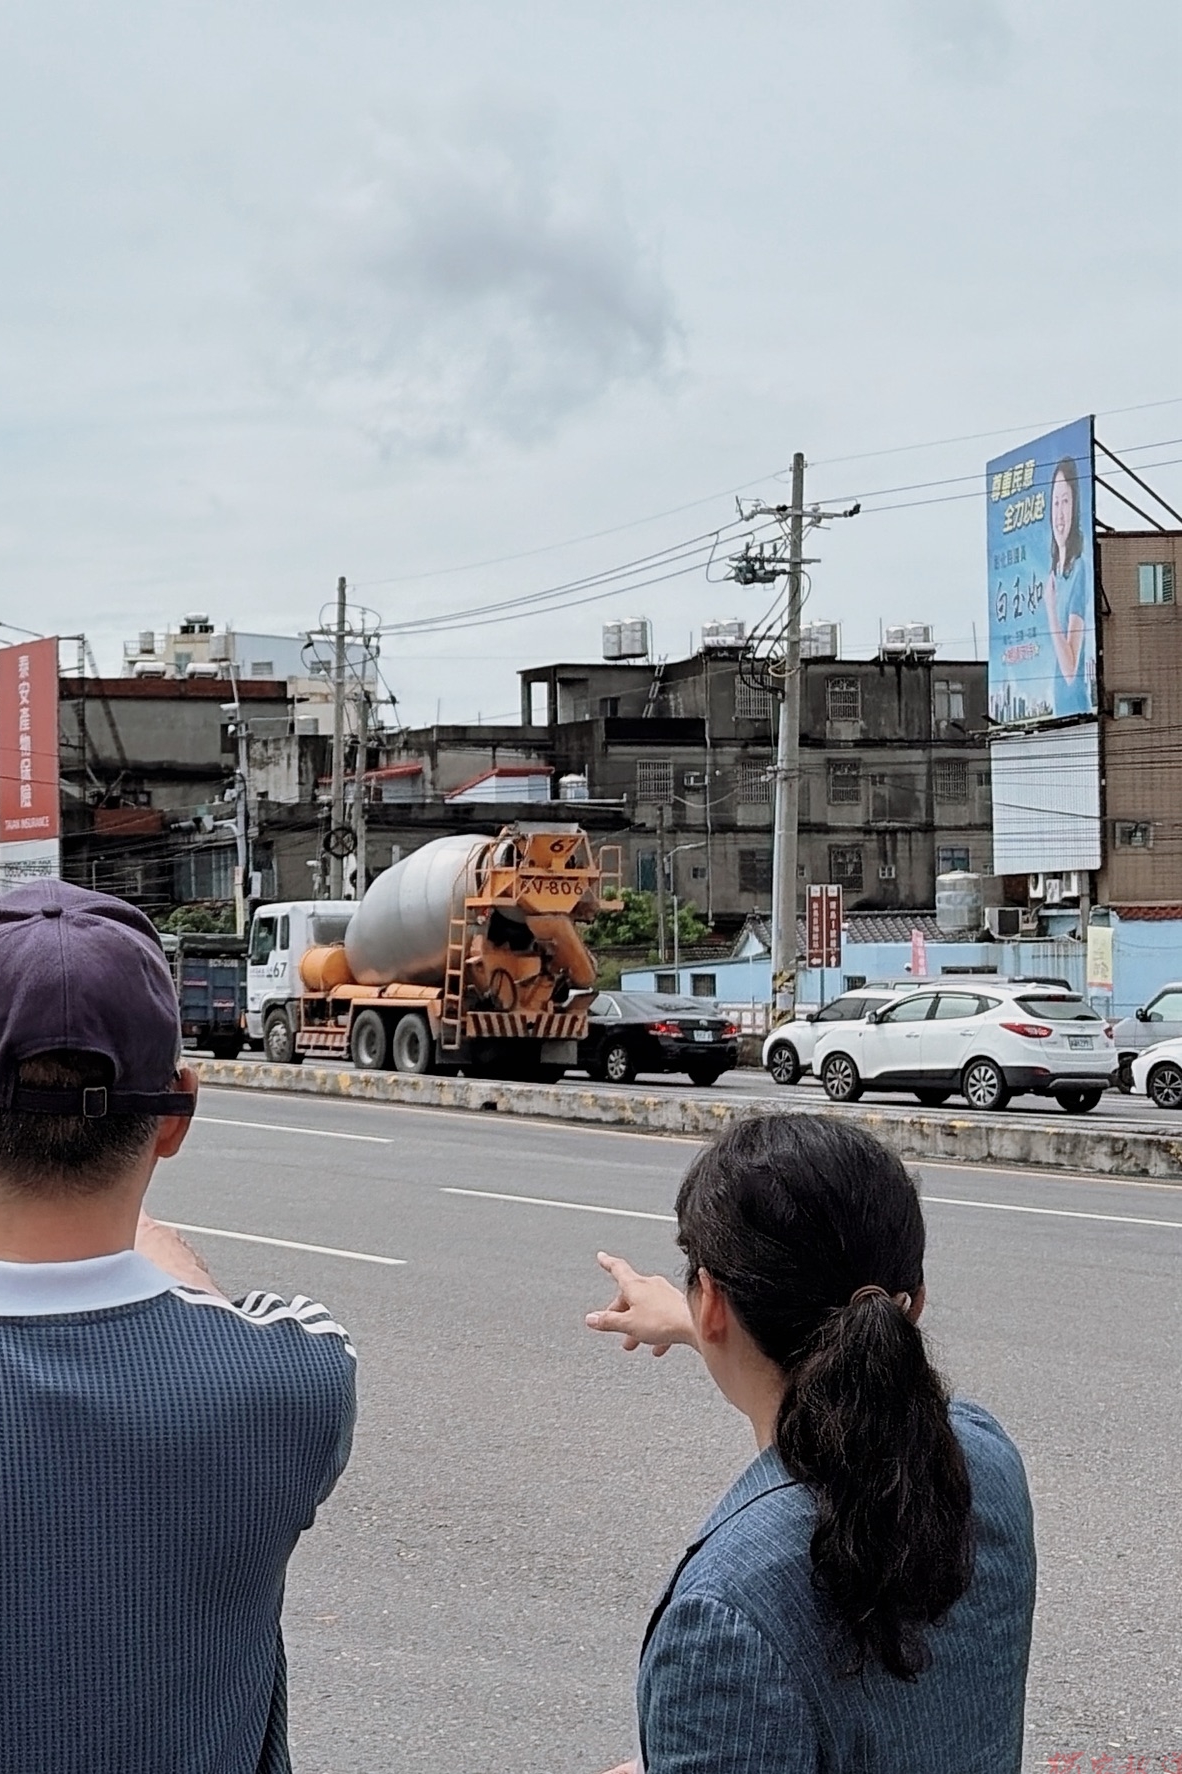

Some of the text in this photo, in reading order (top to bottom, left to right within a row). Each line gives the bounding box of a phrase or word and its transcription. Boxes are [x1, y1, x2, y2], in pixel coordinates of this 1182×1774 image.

[990, 459, 1036, 502] 尊重民意
[1002, 491, 1045, 534] 全力以赴
[995, 571, 1044, 624] 白玉如
[18, 655, 33, 808] 泰安產物保險
[549, 838, 578, 854] 67
[273, 962, 288, 978] 67
